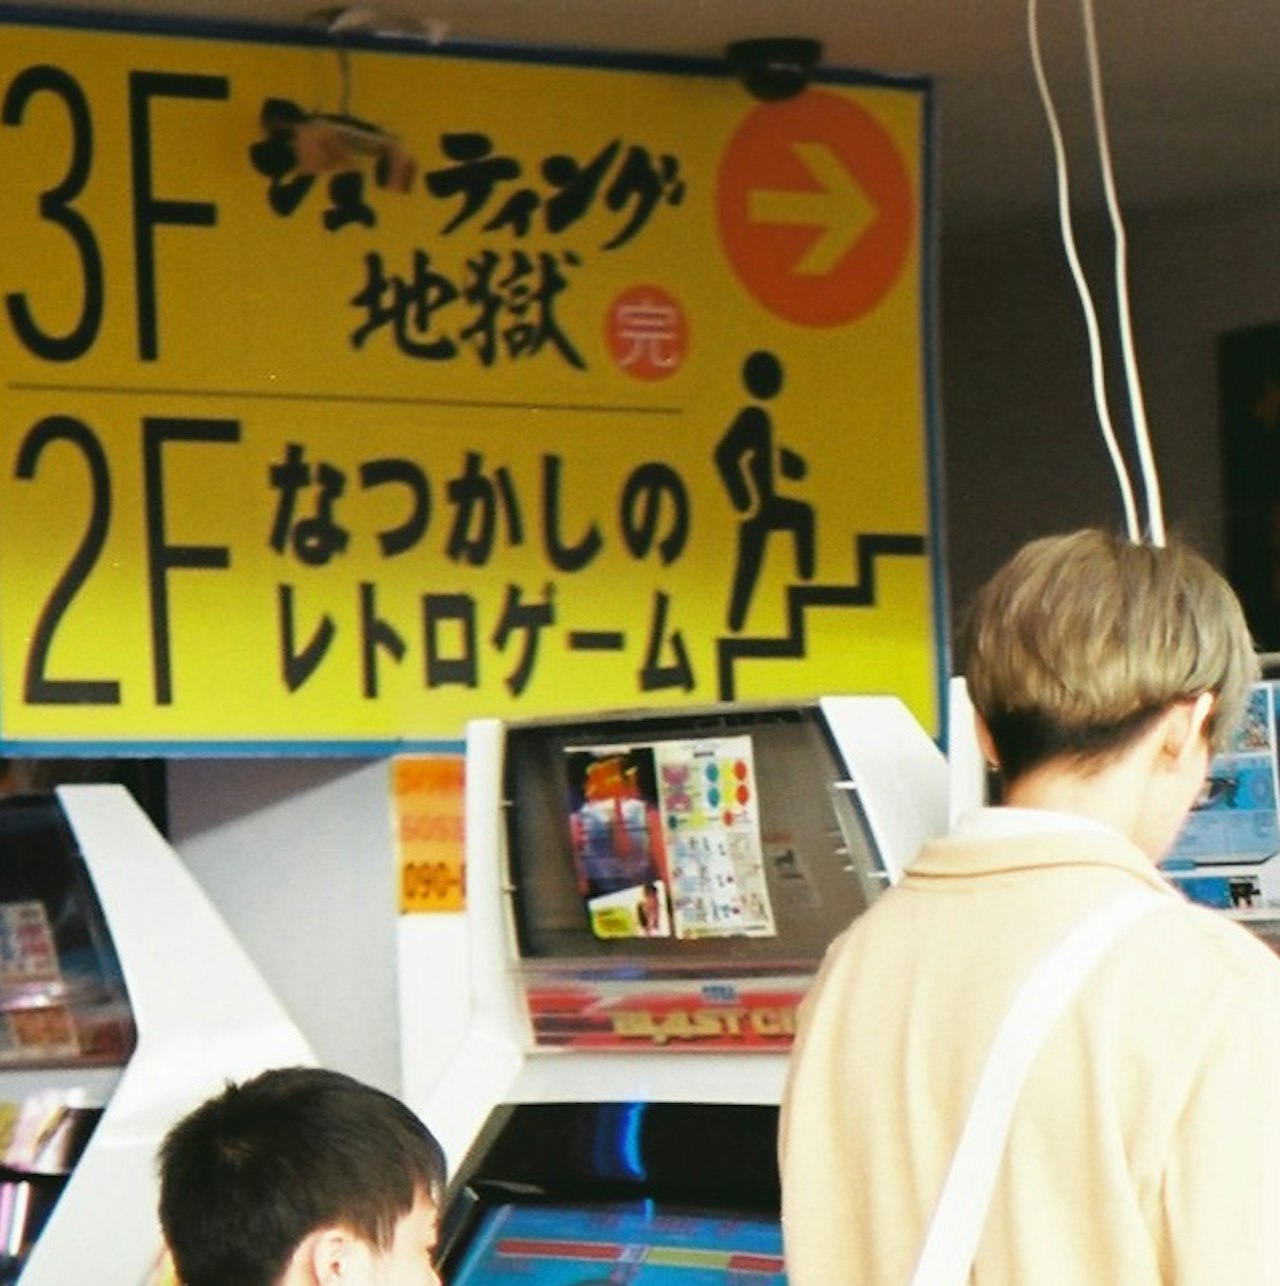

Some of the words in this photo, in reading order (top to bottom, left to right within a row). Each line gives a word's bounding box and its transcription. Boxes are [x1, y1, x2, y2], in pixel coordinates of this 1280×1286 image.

[1, 65, 229, 363] 3F
[249, 97, 686, 252] シュティング
[349, 247, 589, 372] 地獄
[616, 298, 680, 368] 完
[14, 413, 242, 707] 2F
[269, 442, 692, 573] なつかしの
[277, 583, 696, 700] レトロゲーム
